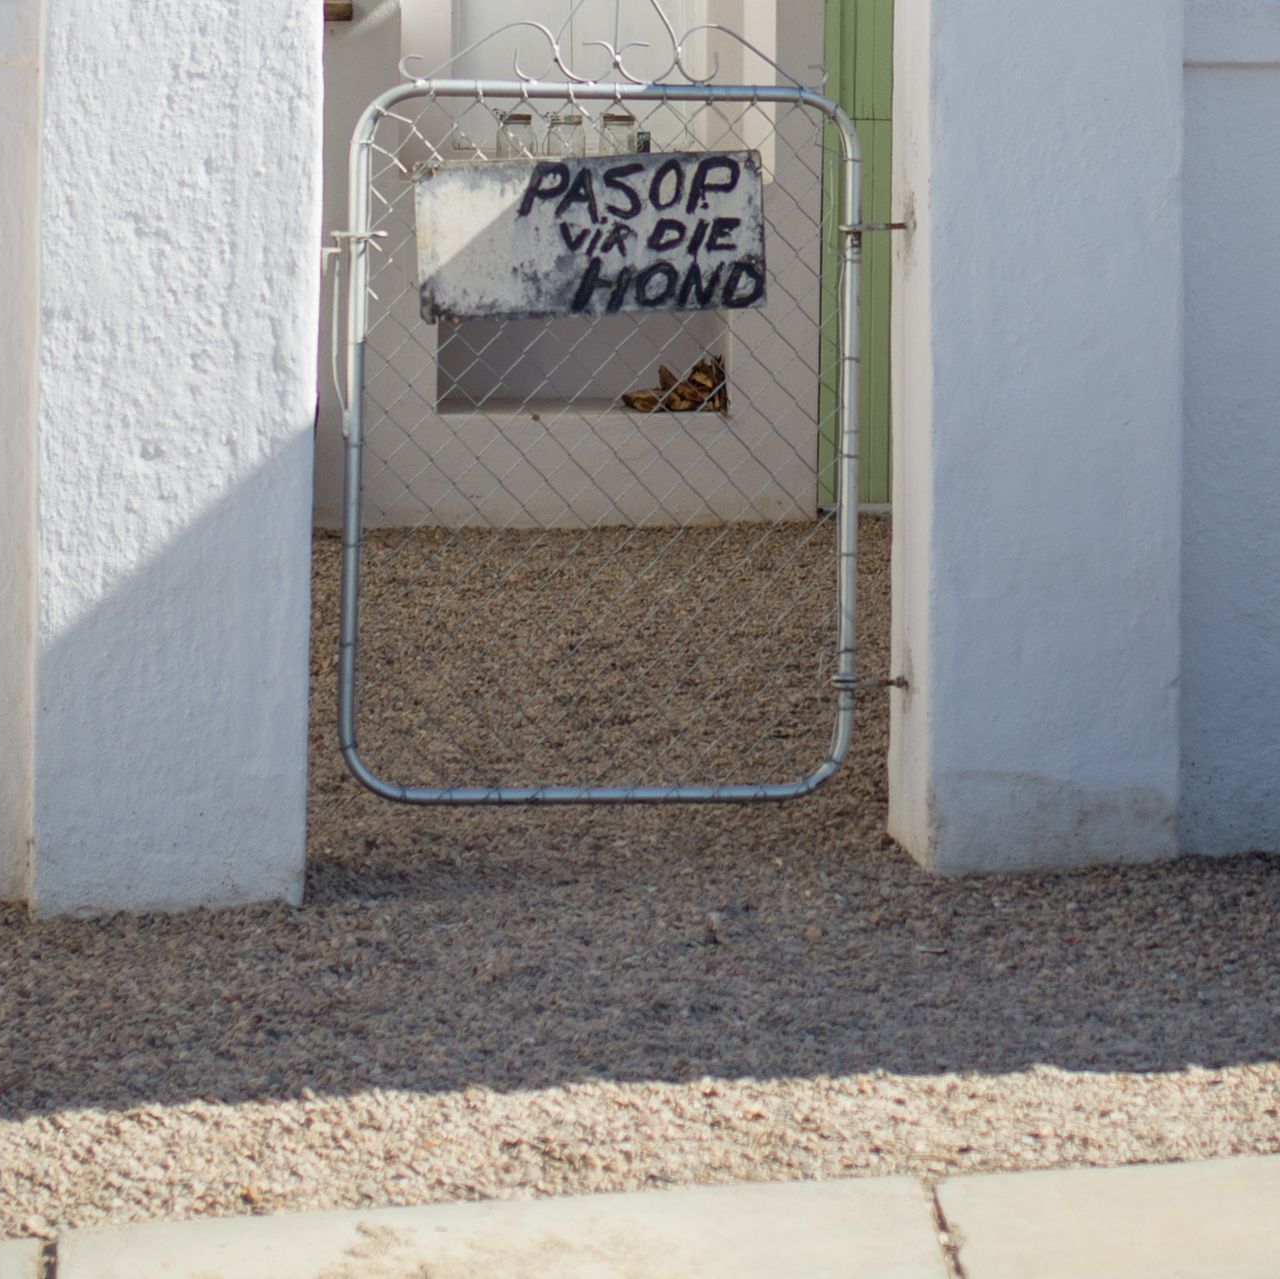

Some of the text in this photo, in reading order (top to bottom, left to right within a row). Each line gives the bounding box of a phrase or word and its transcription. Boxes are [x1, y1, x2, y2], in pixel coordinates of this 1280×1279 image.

[517, 157, 740, 223] PASOP
[647, 218, 740, 257] DIE
[571, 257, 765, 312] HOND
